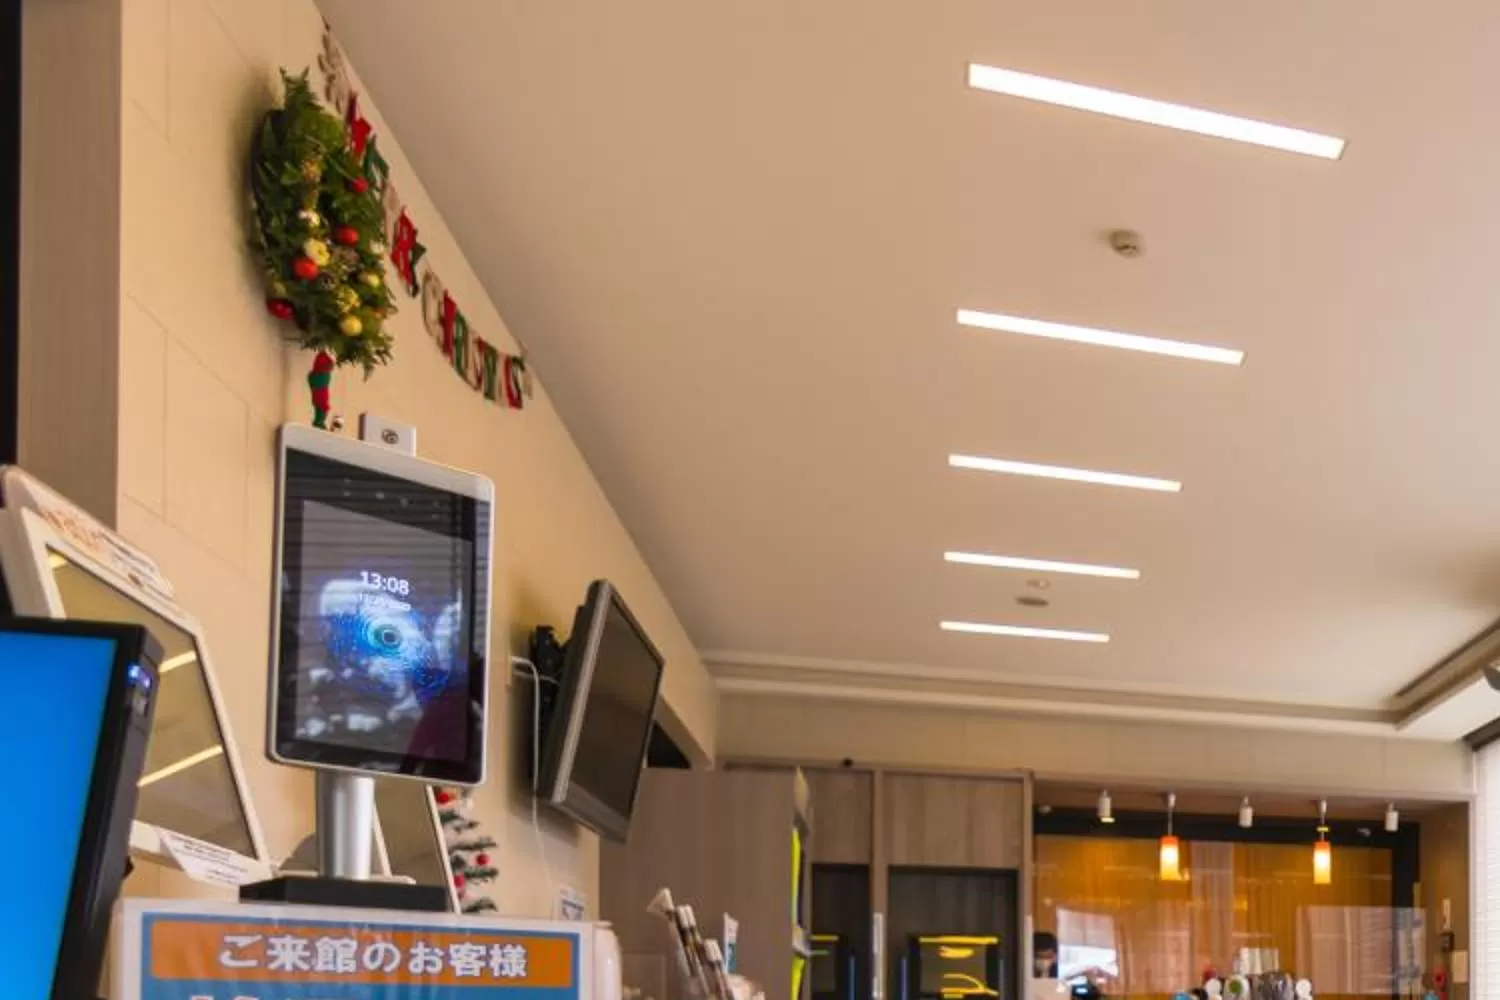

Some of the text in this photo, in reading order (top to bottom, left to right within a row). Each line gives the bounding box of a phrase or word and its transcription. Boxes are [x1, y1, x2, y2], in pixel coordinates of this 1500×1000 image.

[360, 571, 410, 595] 13:08
[219, 934, 528, 977] ご来館のお客様
